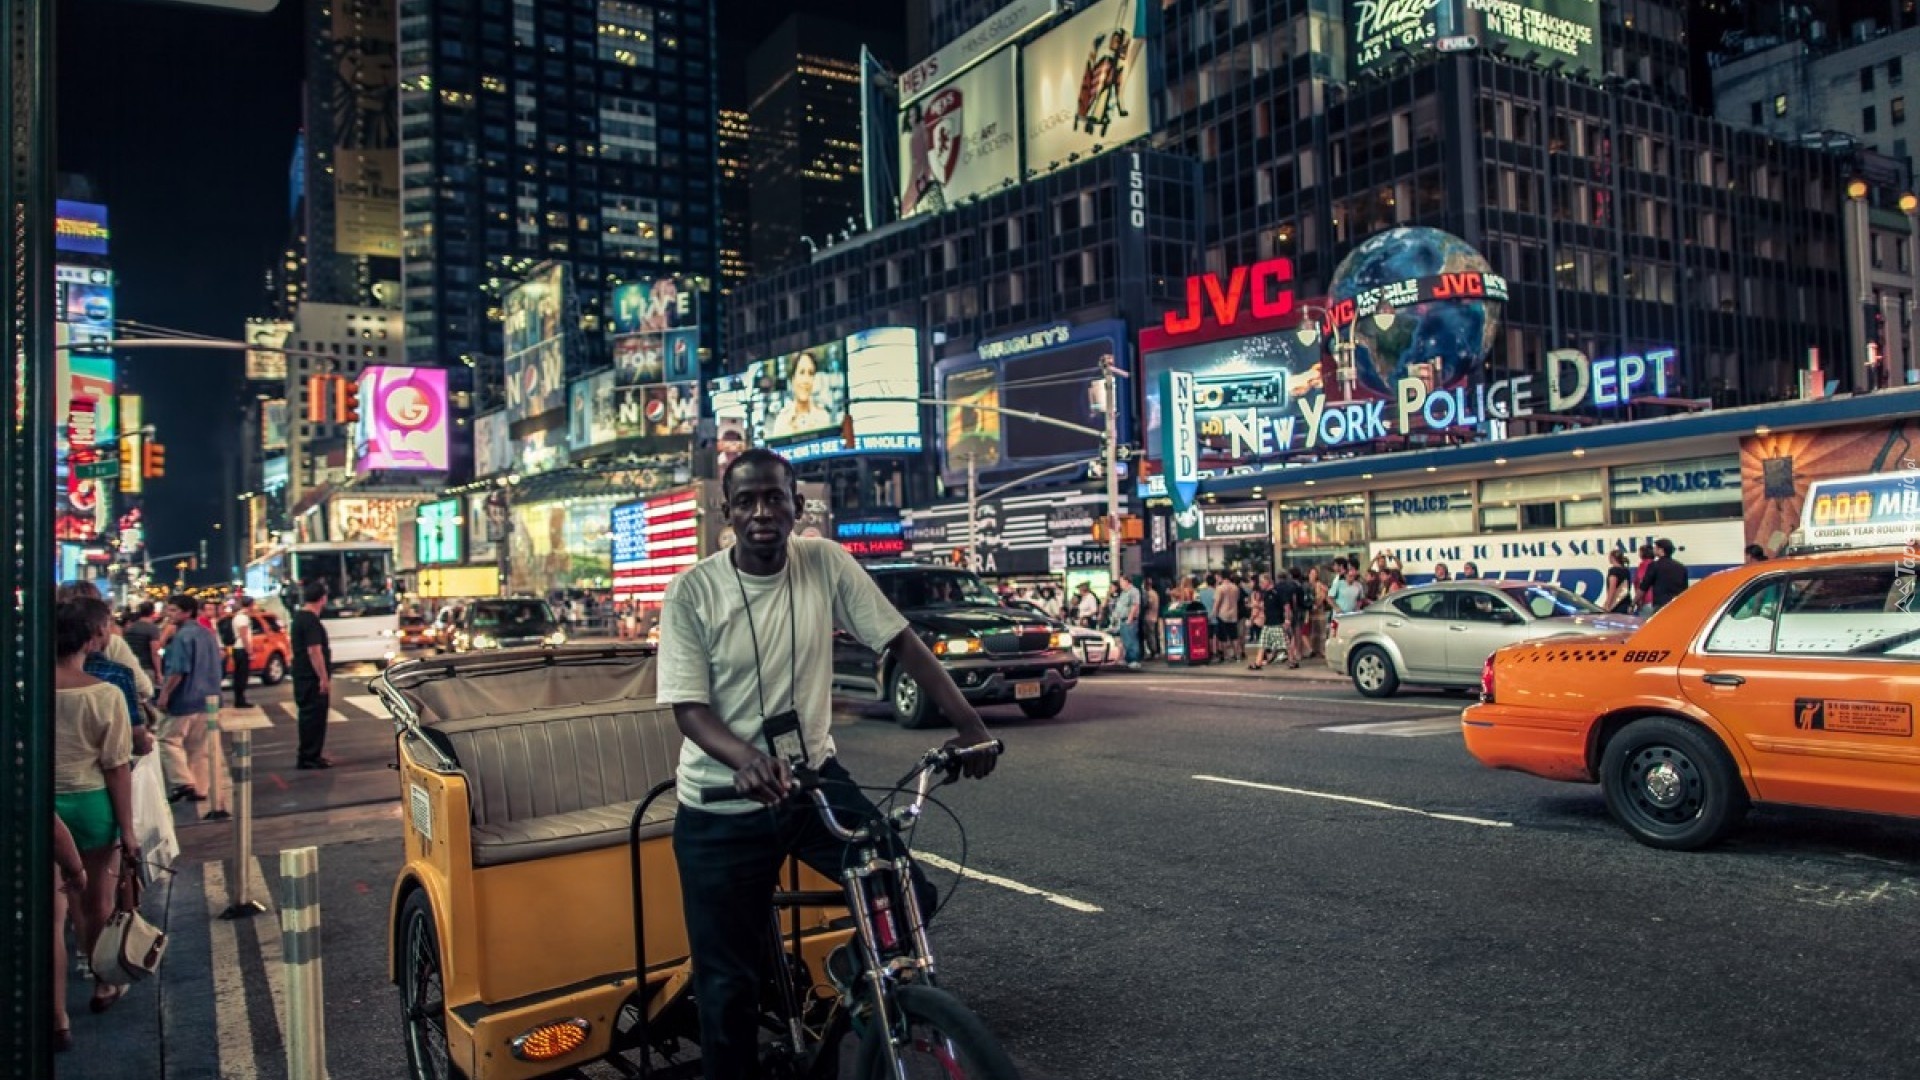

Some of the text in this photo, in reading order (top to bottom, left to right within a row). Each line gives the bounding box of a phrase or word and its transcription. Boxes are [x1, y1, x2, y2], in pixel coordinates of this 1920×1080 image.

[1487, 12, 1578, 56] IN THE UNIVERSE
[1522, 7, 1593, 44] STEAKHOUSE
[1357, 45, 1381, 65] LAS
[902, 57, 938, 93] HEYS
[981, 121, 998, 139] ART
[1131, 152, 1144, 229] 1500
[1164, 257, 1294, 336] JVC
[1432, 271, 1484, 299] JVC
[1322, 299, 1356, 337] JVC
[978, 326, 1070, 360] WRIGLEY'S
[622, 351, 657, 368] FOR
[1224, 347, 1677, 459] NEW YORK POLICE DEPT
[1175, 374, 1192, 478] NYPD
[840, 436, 861, 450] TE
[863, 435, 905, 449] WHOLE
[1640, 469, 1723, 494] POLICE
[1299, 504, 1346, 521] POLICE
[1392, 494, 1449, 515] POLICE
[1204, 513, 1266, 525] STARBUCKS
[1216, 522, 1256, 532] COFFEE
[1814, 527, 1850, 538] CRUISING
[1853, 525, 1875, 536] YEAR
[1068, 550, 1112, 566] SEPHO
[1380, 535, 1660, 563] ELCOME TO TIMES SQUARE
[1623, 650, 1670, 663] 8887
